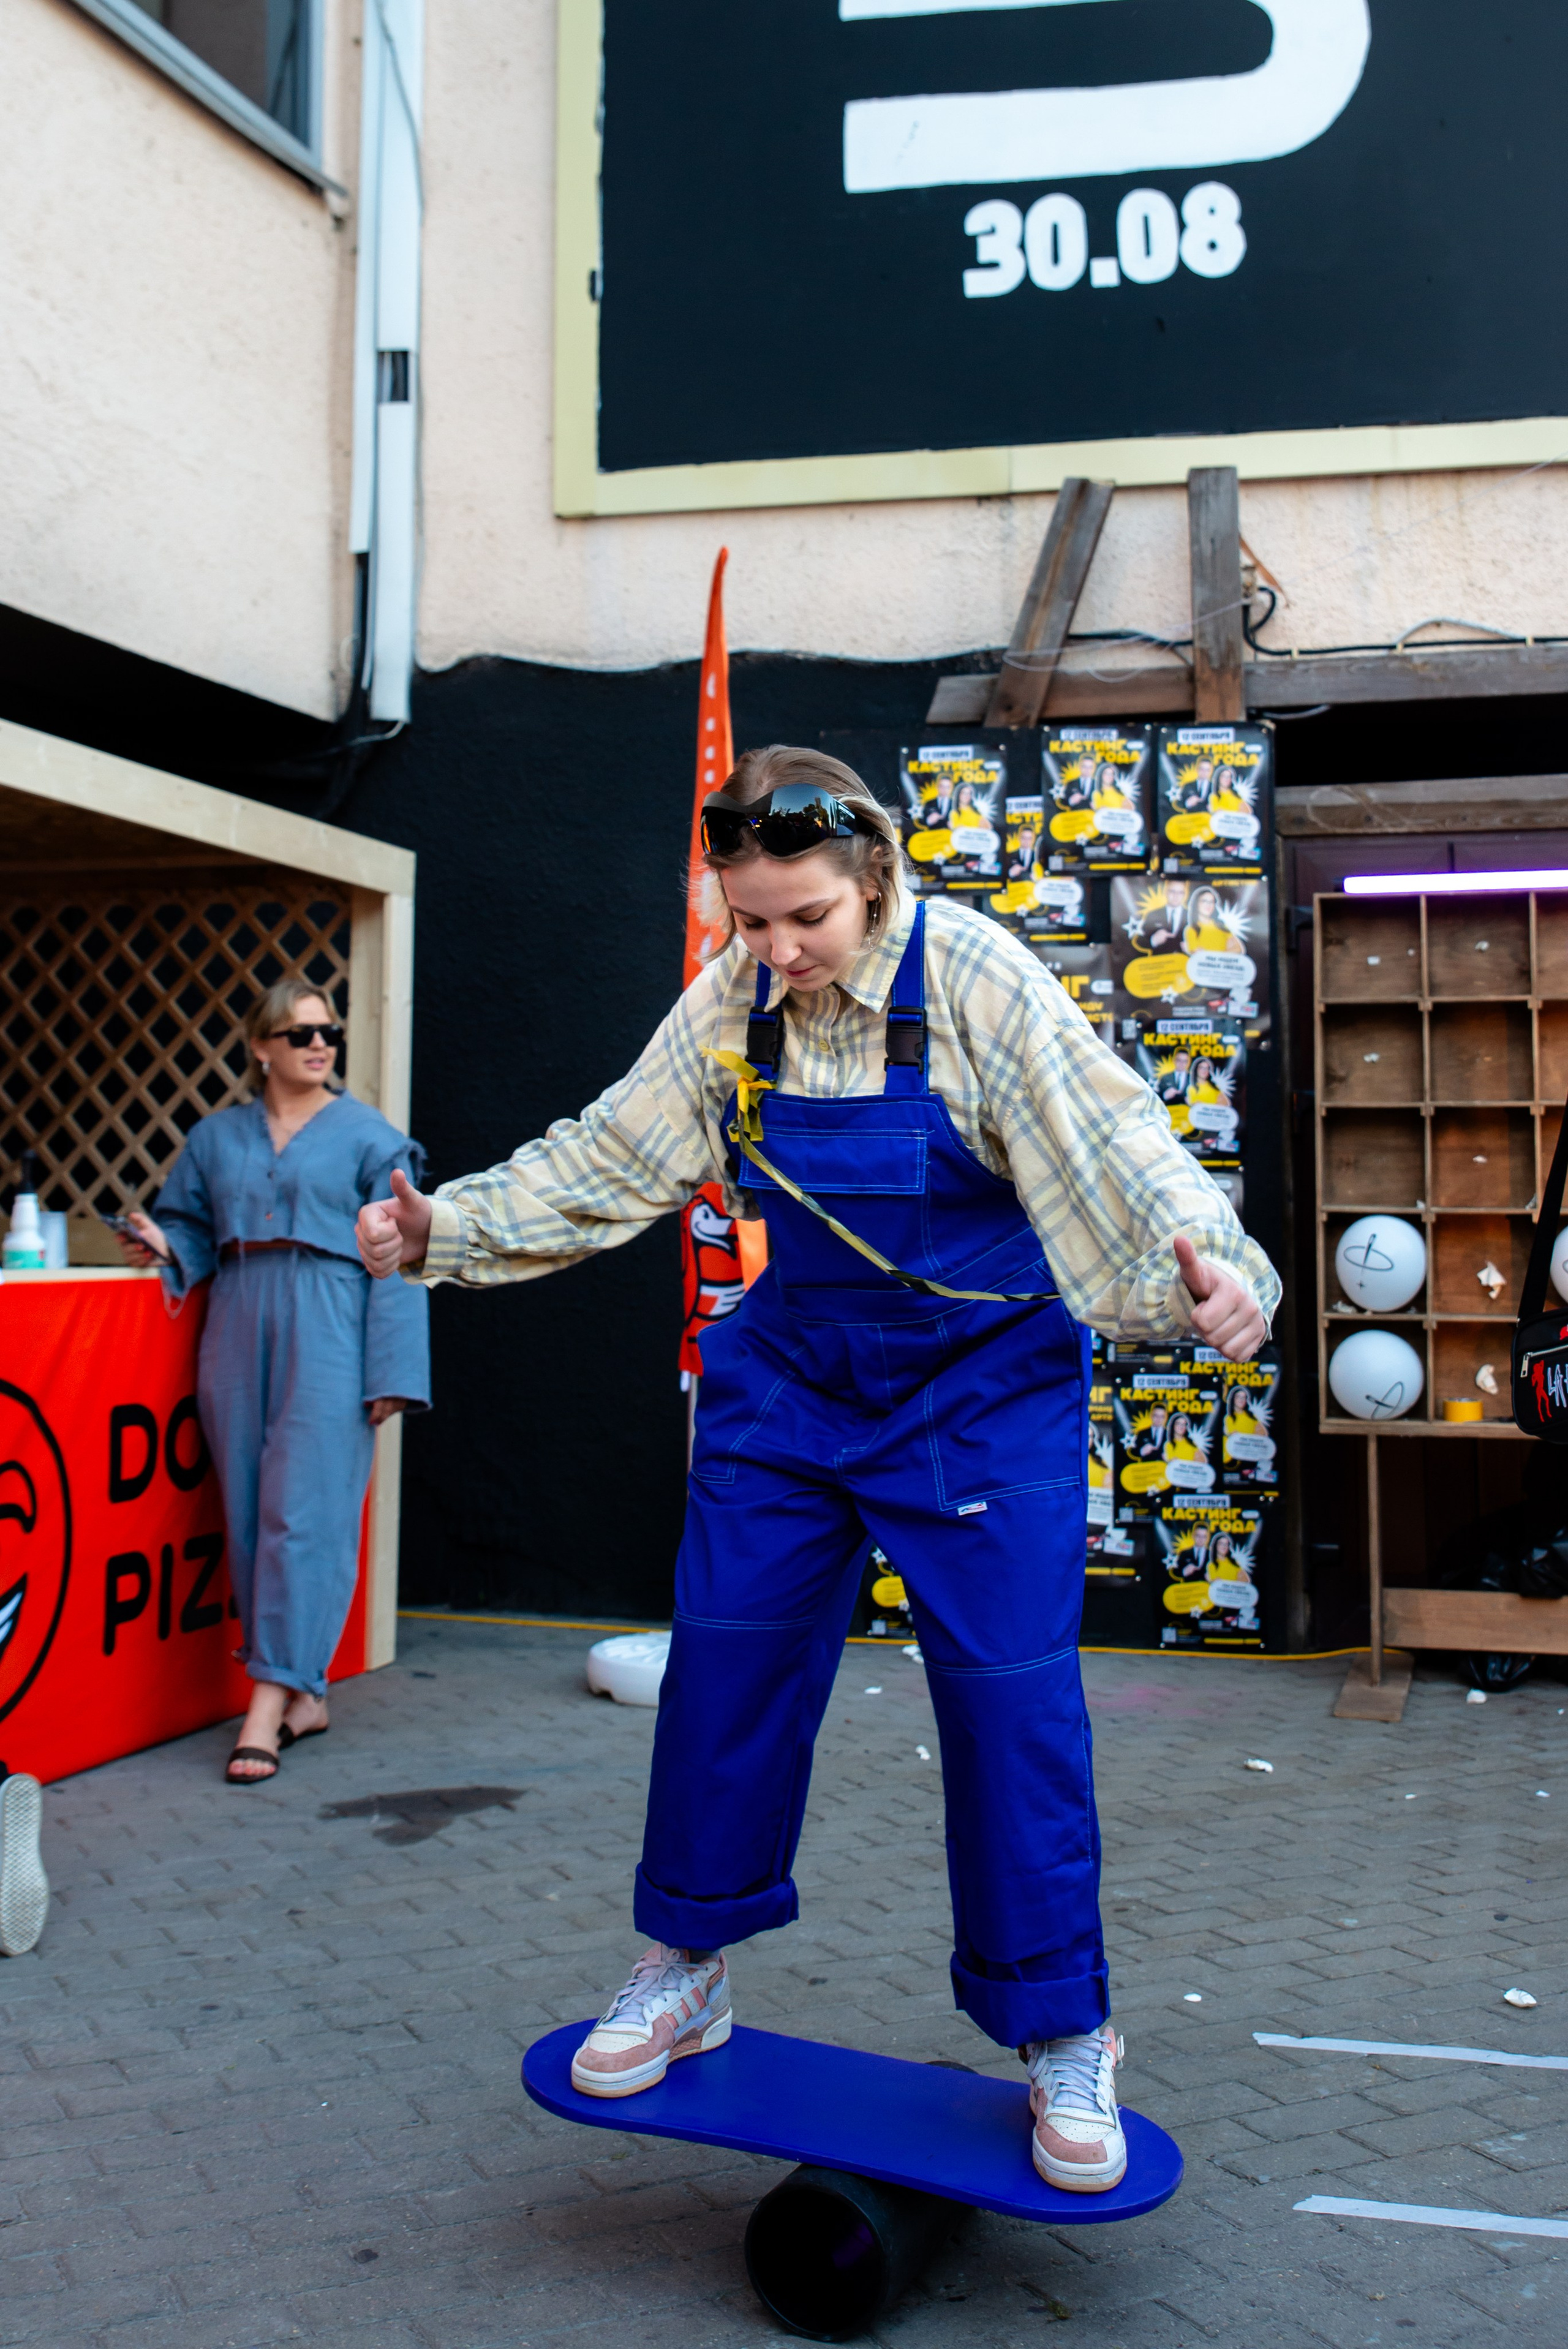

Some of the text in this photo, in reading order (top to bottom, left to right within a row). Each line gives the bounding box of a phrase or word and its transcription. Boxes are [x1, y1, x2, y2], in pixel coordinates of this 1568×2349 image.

[963, 181, 1246, 298] 30.08
[1049, 739, 1128, 753] КАСТИНГ
[1166, 741, 1245, 755] КАСТИНГ
[1095, 750, 1140, 764] ГОДА
[1213, 753, 1259, 767] ГОДА
[908, 759, 984, 774] КАСТИНГ
[952, 769, 997, 783] ГОДА
[1144, 1033, 1222, 1046] КАСТИНГ
[1191, 1044, 1236, 1058] ГОДА
[1180, 1360, 1259, 1374] КАСТИНГ
[1227, 1373, 1273, 1387] ГОДА
[1120, 1387, 1199, 1401] КАСТИНГ
[1167, 1400, 1213, 1414] ГОДА
[1162, 1507, 1241, 1520] КАСТИНГ
[1210, 1519, 1256, 1534] ГОДА
[103, 1533, 239, 1656] PIZ
